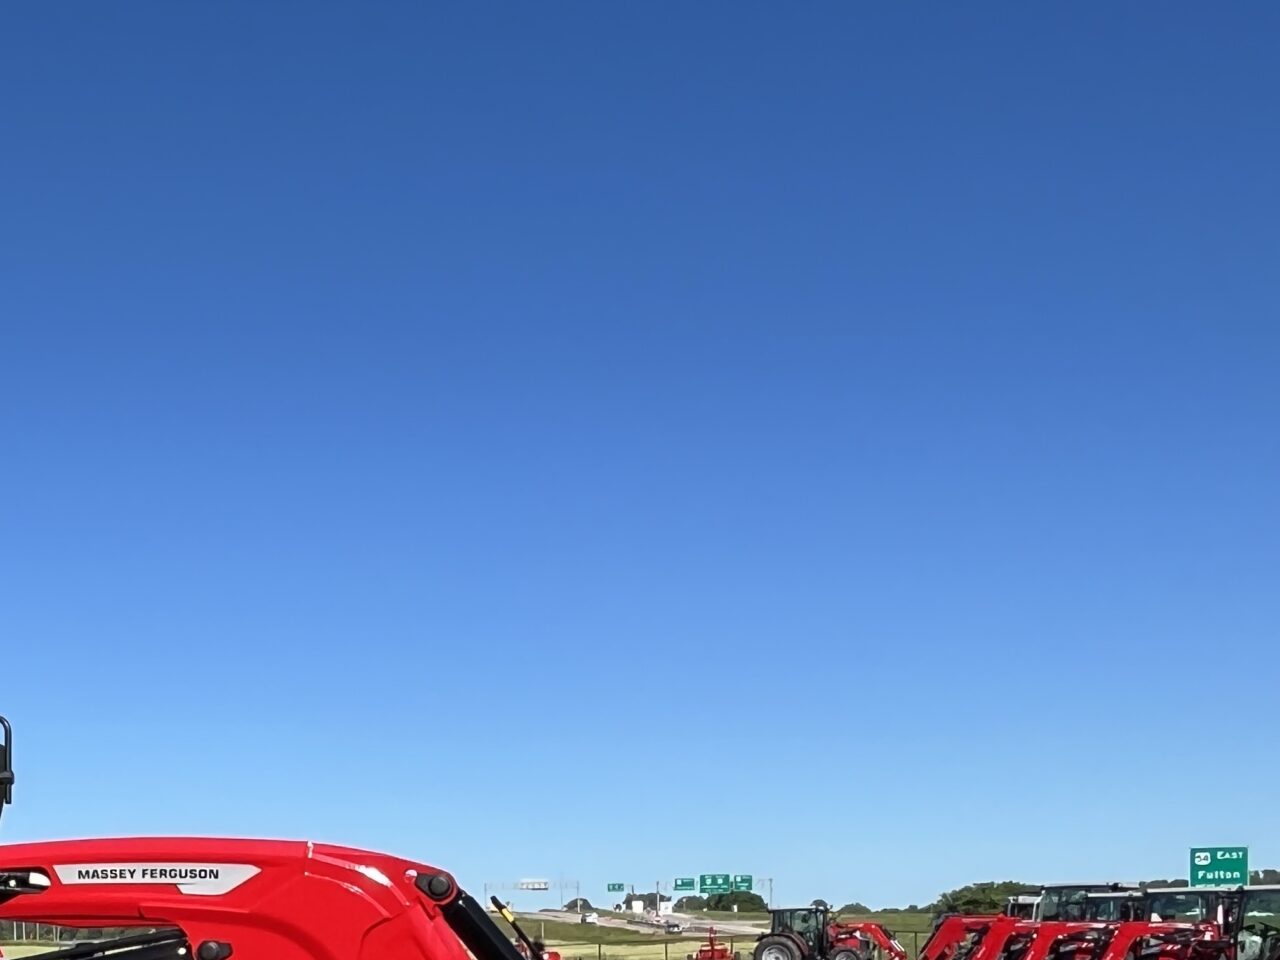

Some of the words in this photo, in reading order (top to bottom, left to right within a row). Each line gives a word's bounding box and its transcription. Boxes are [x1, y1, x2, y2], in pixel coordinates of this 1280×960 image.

[1216, 851, 1244, 859] EAST
[77, 869, 137, 880] MASSEY
[141, 868, 219, 880] FERGUSON
[1197, 870, 1241, 880] Fulton
